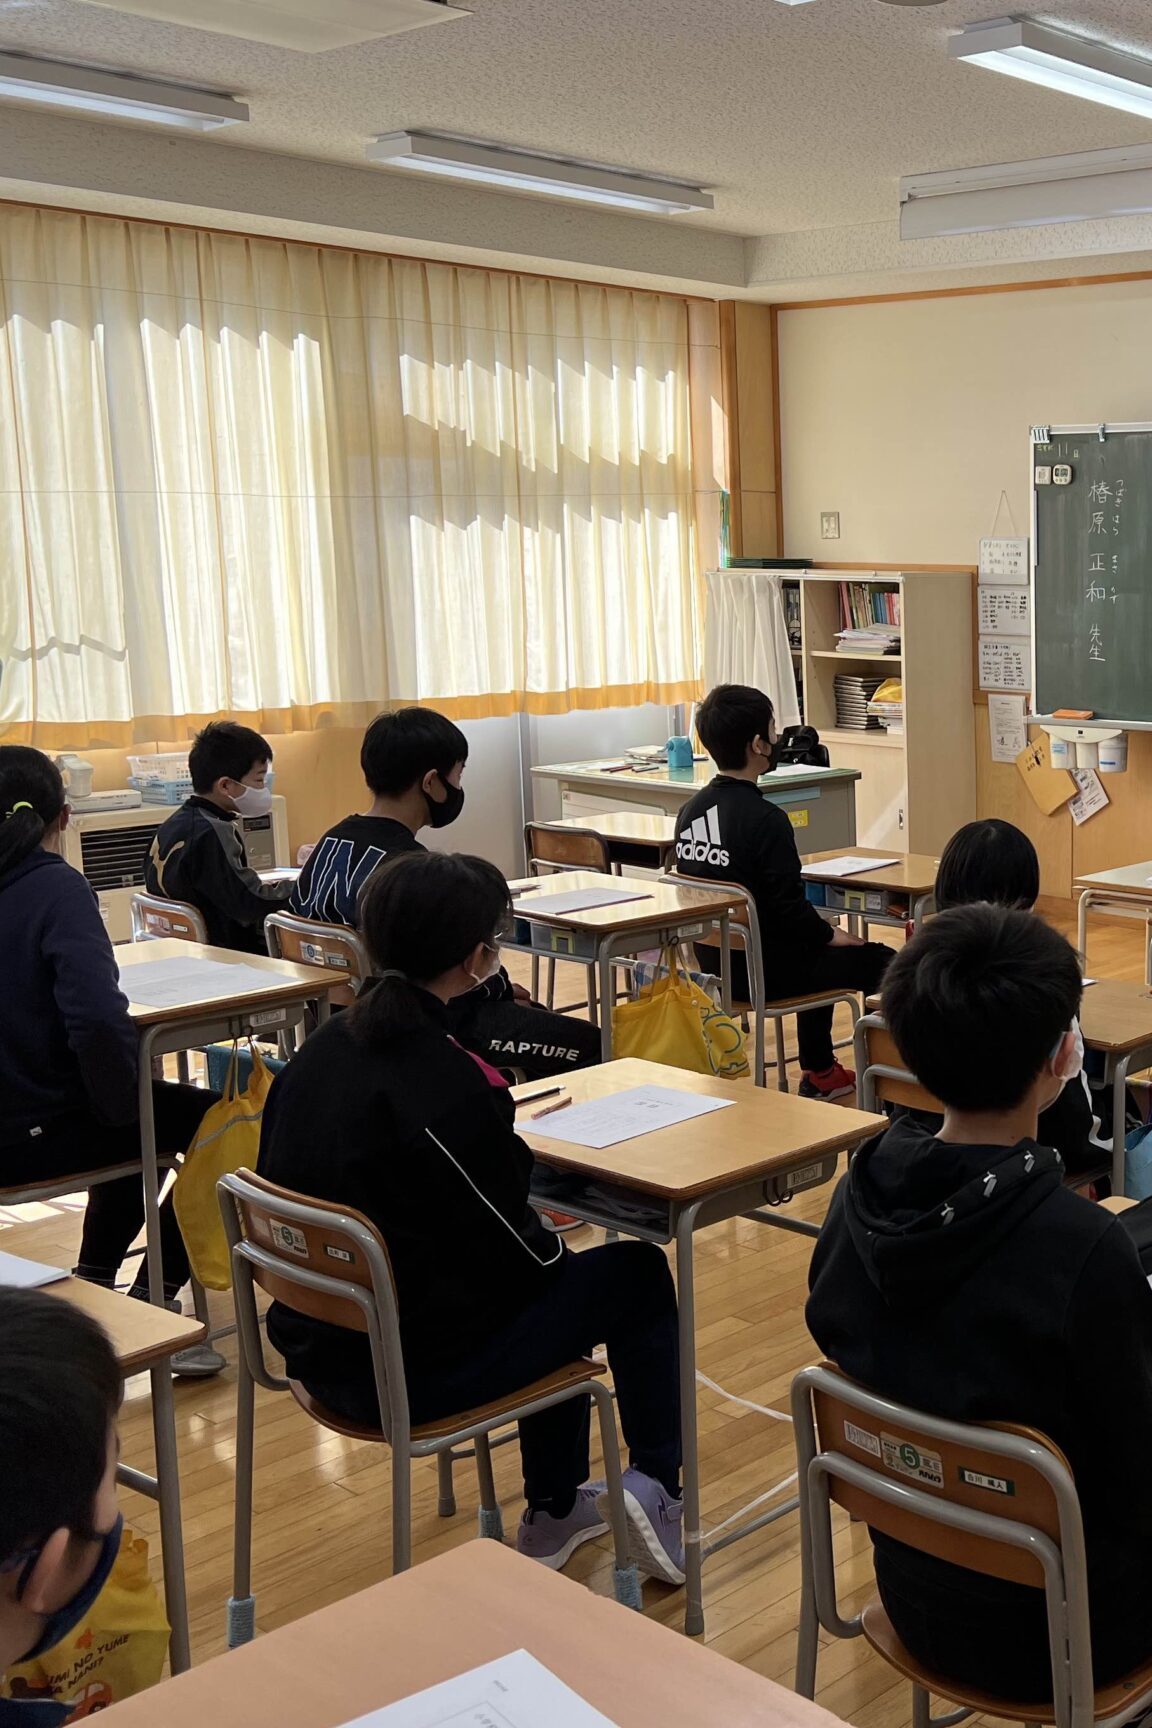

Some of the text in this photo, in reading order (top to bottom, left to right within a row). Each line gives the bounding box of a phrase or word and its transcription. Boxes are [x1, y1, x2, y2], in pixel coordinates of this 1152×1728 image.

[676, 840, 729, 867] adidas
[488, 1039, 580, 1061] RAPTURE
[904, 1446, 916, 1467] 5
[74, 1653, 93, 1672] NO
[97, 1632, 130, 1654] YUME
